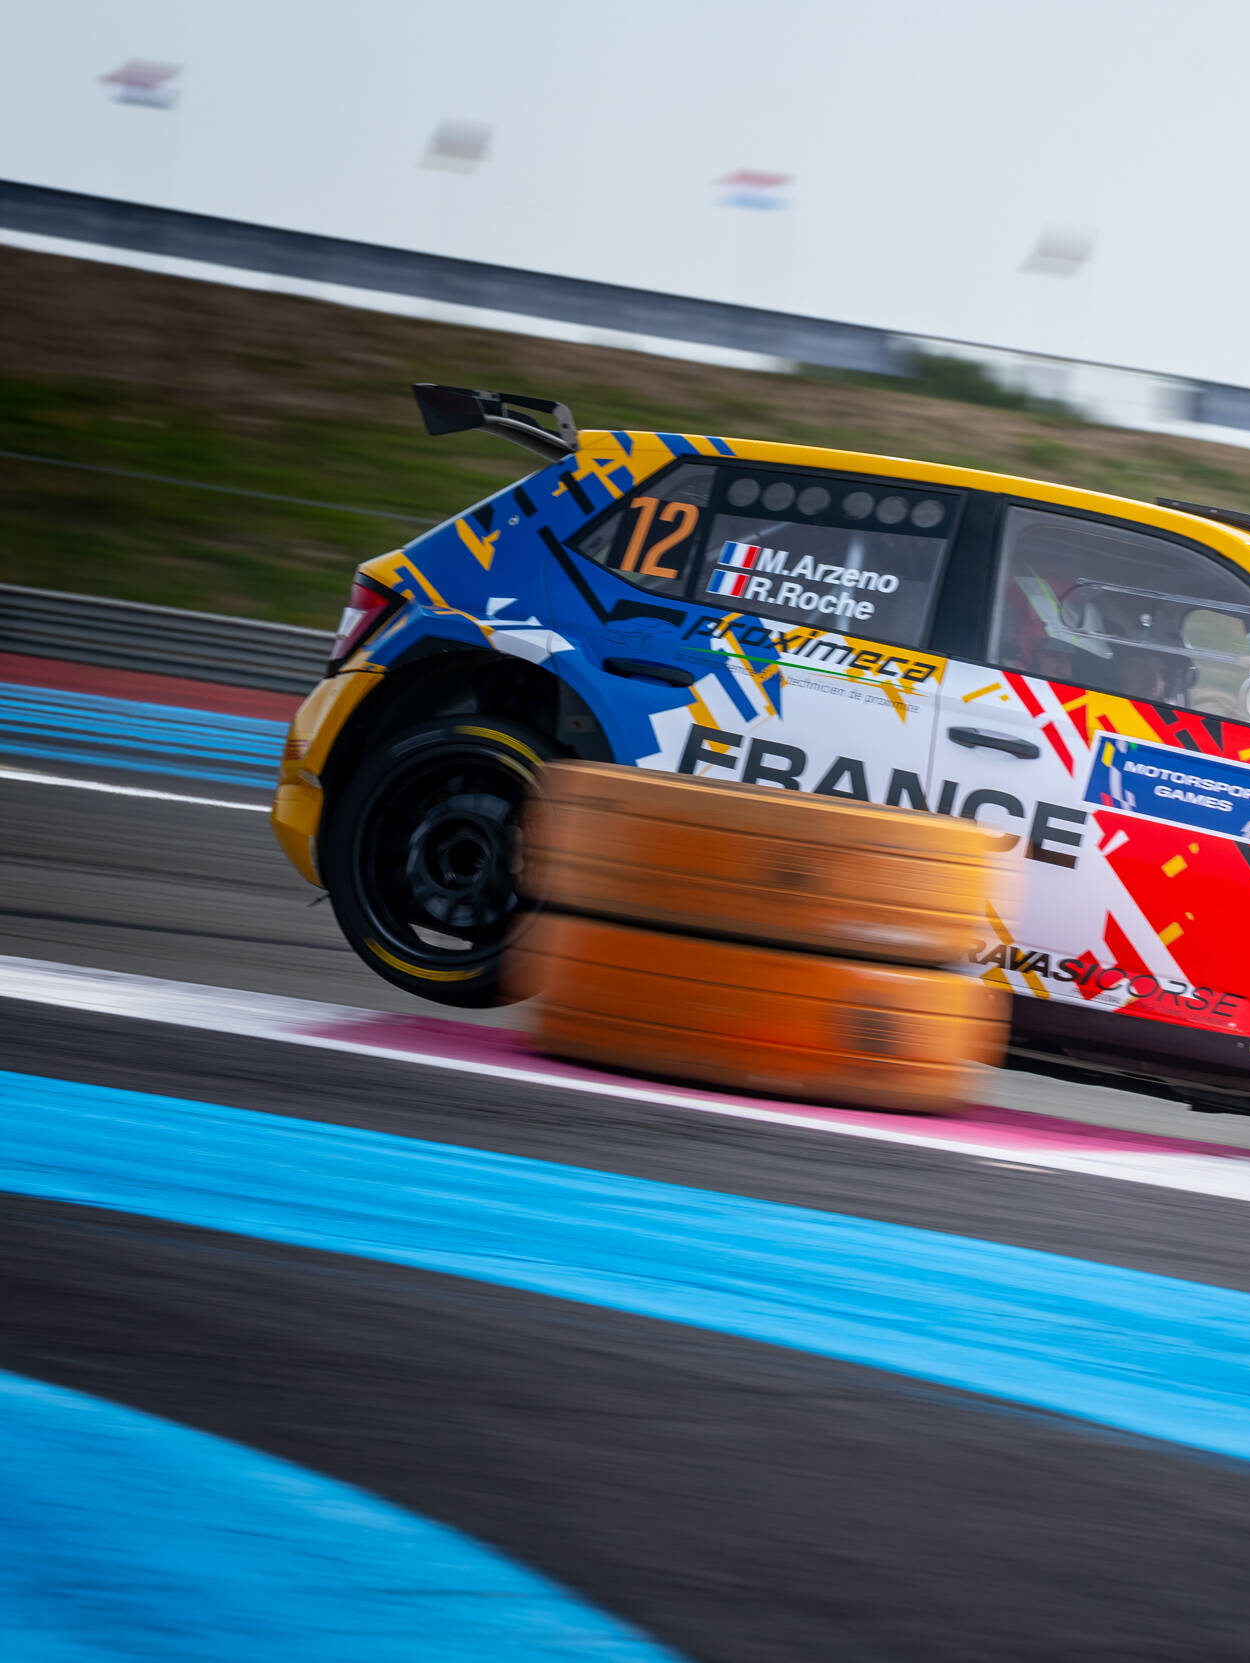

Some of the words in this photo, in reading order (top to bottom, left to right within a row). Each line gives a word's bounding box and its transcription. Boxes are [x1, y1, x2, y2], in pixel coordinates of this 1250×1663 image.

[619, 496, 700, 579] 12
[744, 578, 876, 621] R.Roche
[755, 548, 900, 595] M.Arzeno
[681, 613, 942, 685] proximeca
[677, 722, 1088, 870] FRANCE
[1153, 785, 1234, 813] GAMES
